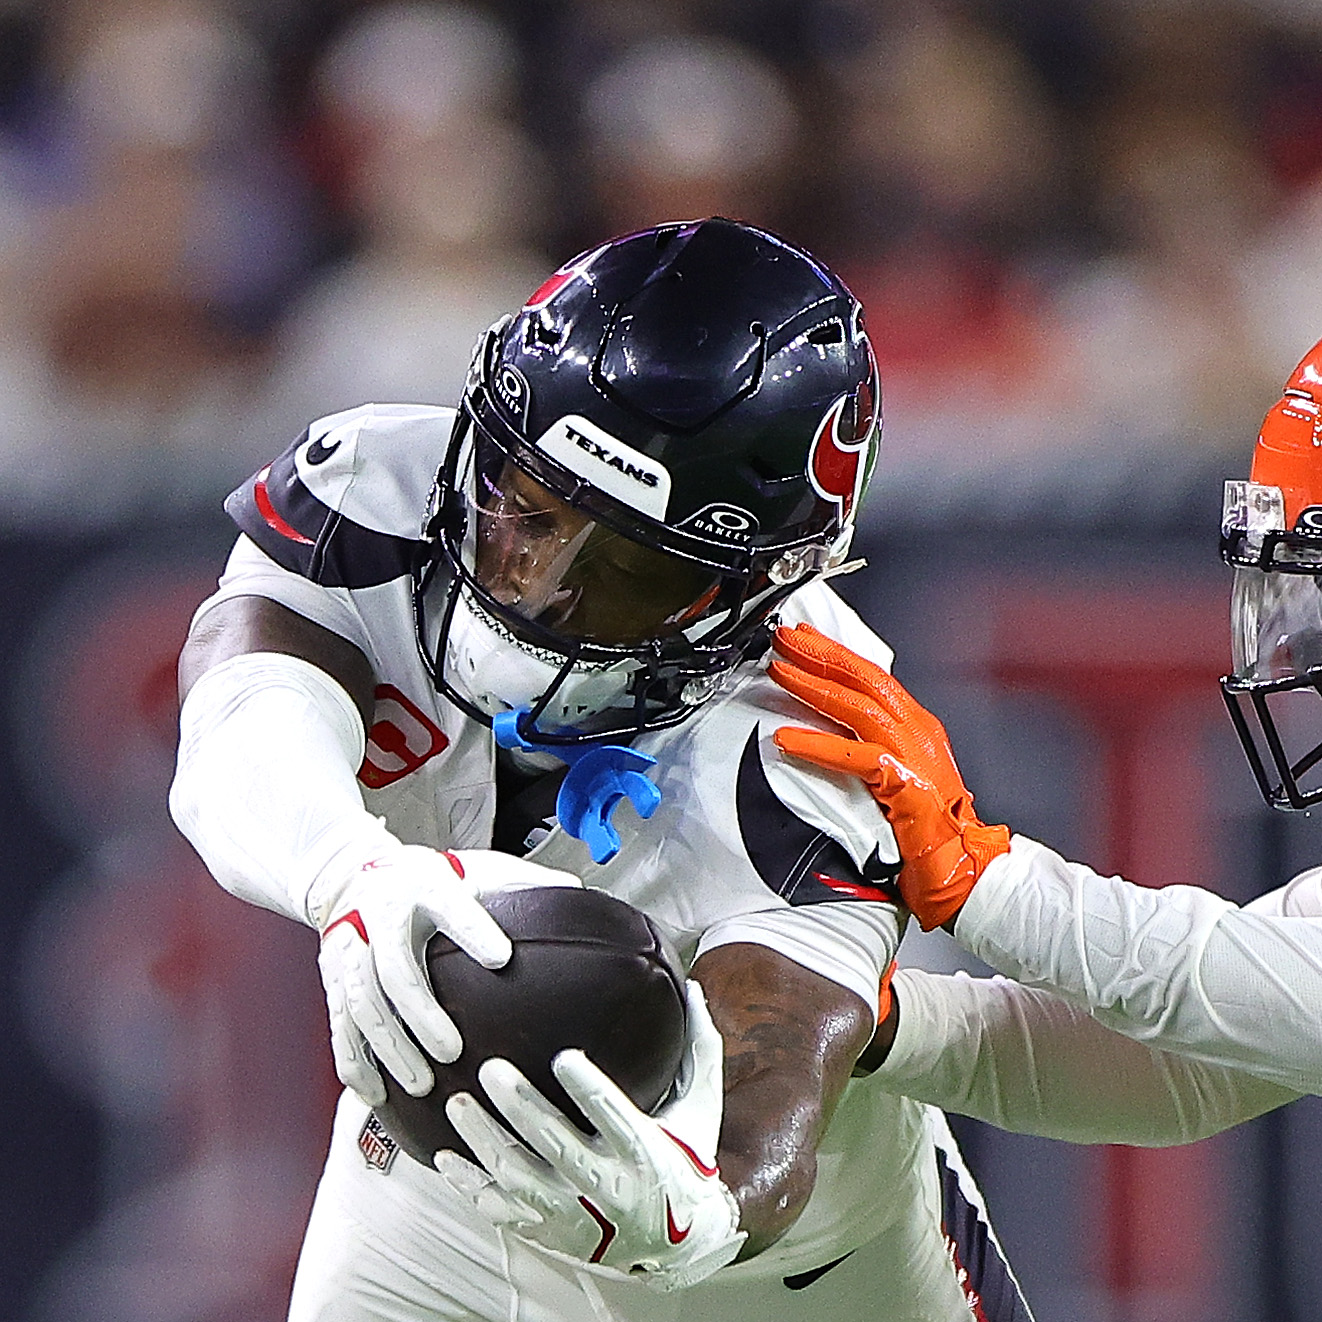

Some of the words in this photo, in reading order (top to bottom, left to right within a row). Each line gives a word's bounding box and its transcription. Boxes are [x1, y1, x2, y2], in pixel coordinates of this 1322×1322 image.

[563, 423, 660, 488] TEXANS
[694, 519, 752, 542] OAKLEY
[360, 1131, 387, 1168] NFL
